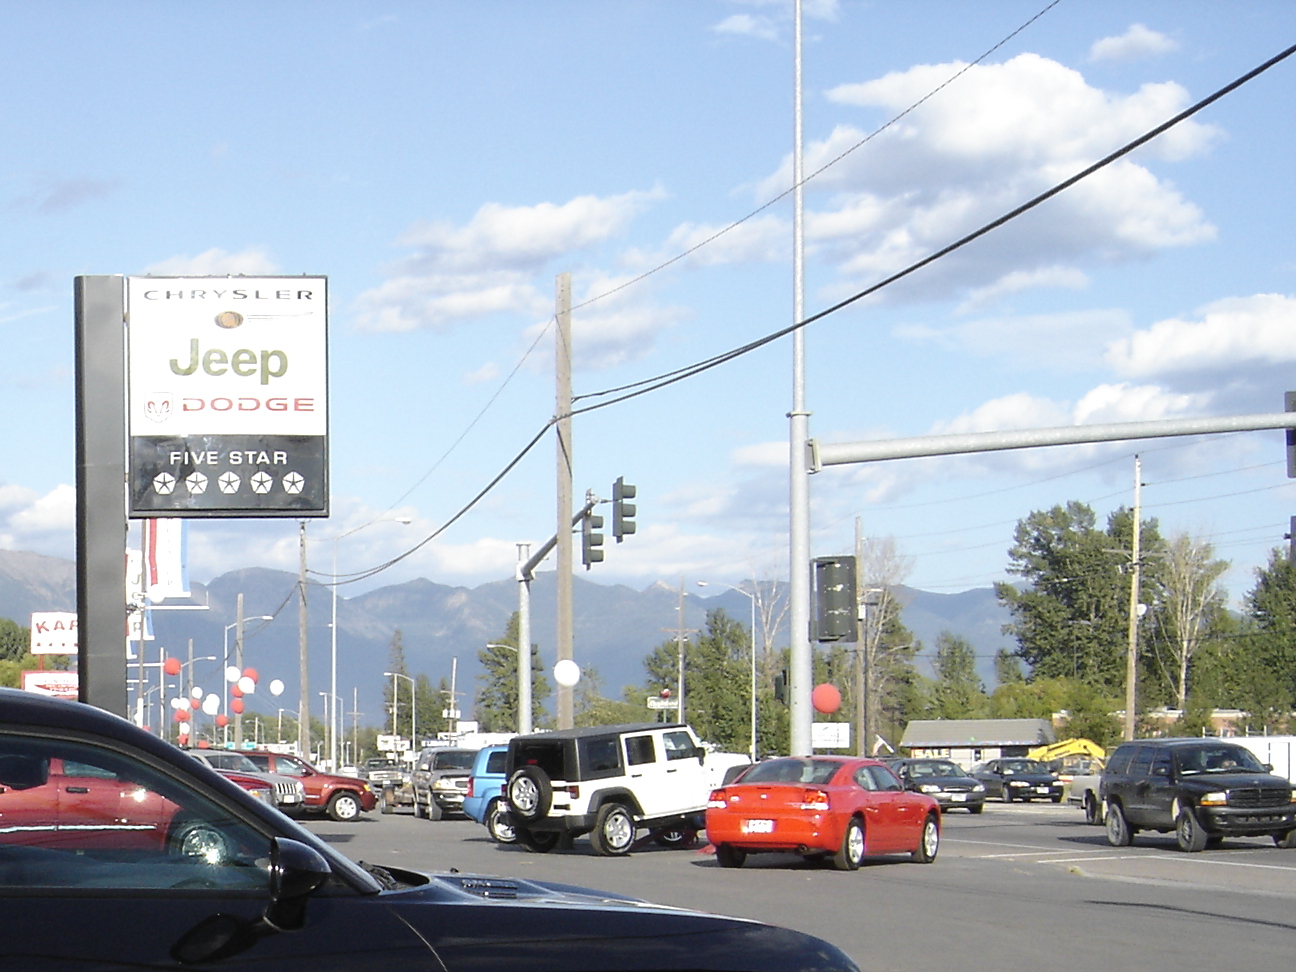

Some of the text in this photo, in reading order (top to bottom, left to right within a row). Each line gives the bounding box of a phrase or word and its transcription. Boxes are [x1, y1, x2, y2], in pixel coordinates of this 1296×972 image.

[143, 289, 314, 301] CHRYSLER
[169, 337, 289, 386] Jeep
[182, 397, 315, 412] DODGE
[169, 451, 288, 466] FIVE STAR
[914, 748, 950, 759] SALE
